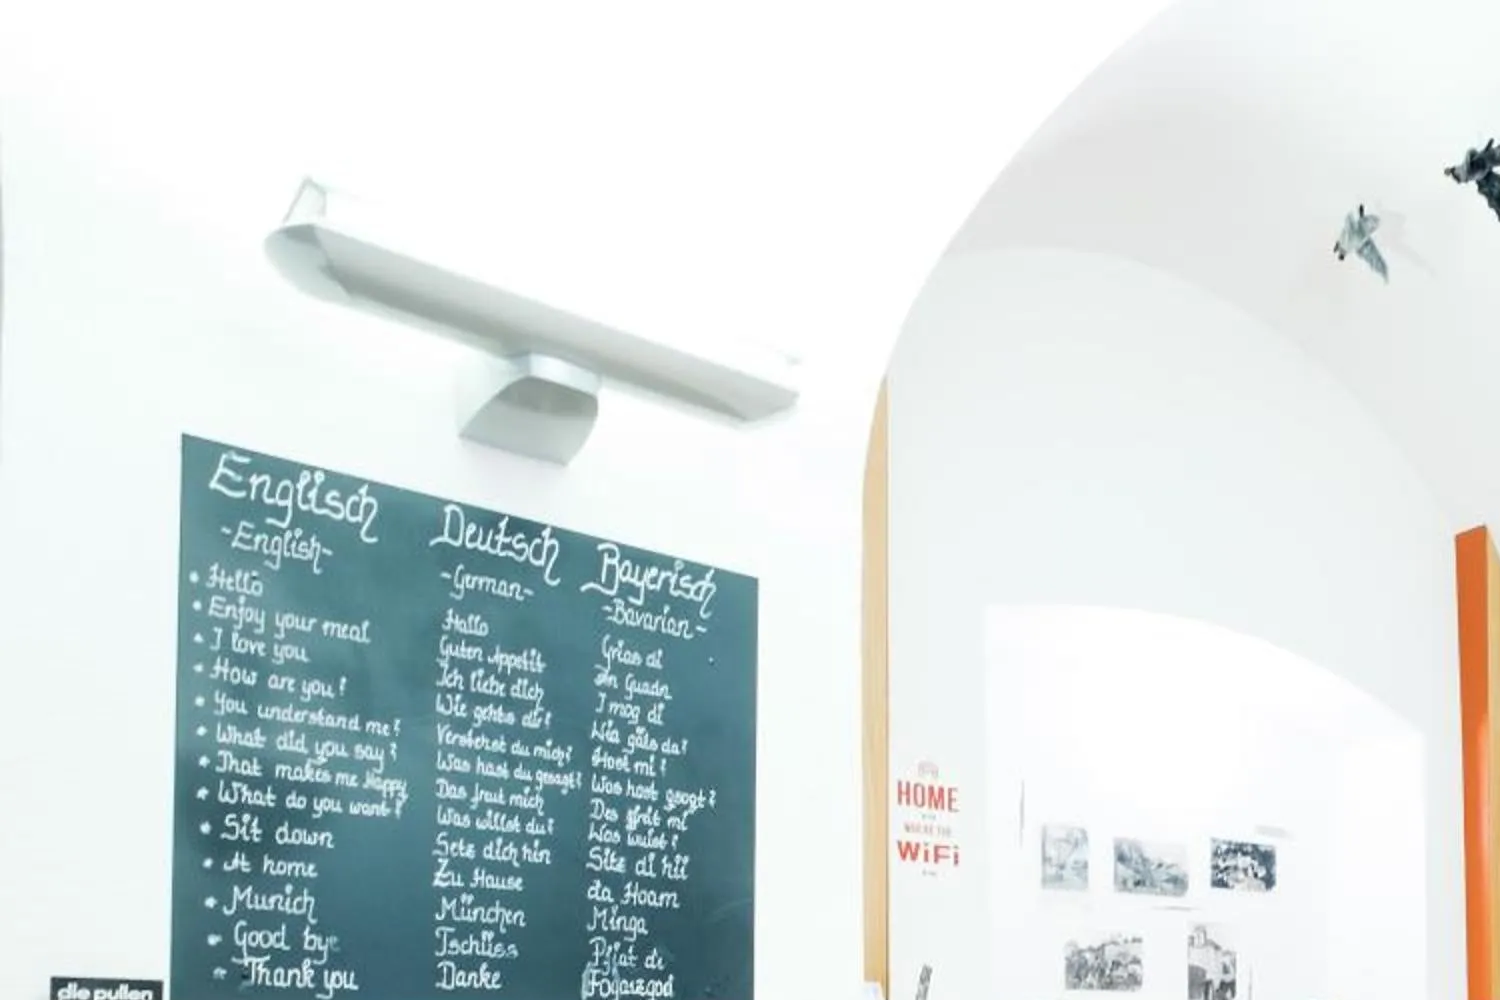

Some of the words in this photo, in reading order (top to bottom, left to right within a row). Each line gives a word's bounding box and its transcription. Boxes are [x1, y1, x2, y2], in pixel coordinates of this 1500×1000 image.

[207, 450, 379, 544] Englisch
[428, 503, 562, 587] Deutsch
[205, 562, 264, 597] Hello
[579, 542, 717, 620] Bayerisch
[207, 594, 266, 635] Enjoy
[273, 610, 318, 639] your
[321, 619, 372, 644] meal
[441, 607, 490, 638] Hallo
[209, 627, 223, 651] I
[230, 630, 267, 658] love
[271, 641, 311, 665] you
[435, 633, 484, 664] Guten
[486, 643, 548, 677] Appetit
[644, 647, 664, 671] di
[209, 656, 258, 687] How
[267, 673, 297, 694] are
[435, 661, 466, 692] Ich
[469, 667, 507, 699] liebe
[509, 677, 545, 713] dich
[213, 690, 250, 716] You
[256, 704, 362, 733] understand
[435, 692, 468, 719] Wie
[607, 701, 642, 726] mog
[646, 702, 666, 726] di
[216, 721, 268, 750] What
[275, 729, 309, 755] did
[307, 738, 349, 766] you
[510, 738, 532, 757] du
[214, 749, 264, 778] That
[274, 760, 333, 785] makes
[334, 771, 359, 789] me
[435, 748, 472, 774] Was
[475, 754, 510, 781] hast
[513, 761, 533, 783] du
[216, 780, 278, 807] What
[284, 790, 308, 811] do
[311, 796, 343, 819] you
[435, 776, 469, 800] Das
[508, 785, 546, 818] mich
[590, 772, 624, 797] Was
[896, 779, 960, 814] HOME
[219, 813, 264, 843] Sit
[274, 821, 336, 850] down
[435, 803, 472, 830] Was
[474, 807, 522, 834] willst
[587, 821, 622, 845] Was
[262, 854, 319, 879] home
[482, 836, 522, 869] dich
[521, 838, 552, 866] hin
[634, 851, 658, 879] di
[896, 838, 960, 868] WiFi
[431, 857, 466, 889] Zu
[468, 866, 525, 892] Hause
[586, 877, 616, 904] da
[222, 884, 318, 925] Munich
[434, 891, 528, 935] München
[585, 903, 650, 942] Minga
[230, 919, 292, 965] Good
[433, 925, 520, 960] Tschüss
[243, 954, 317, 989] Thank
[314, 965, 360, 1000] you
[434, 959, 504, 991] Danke
